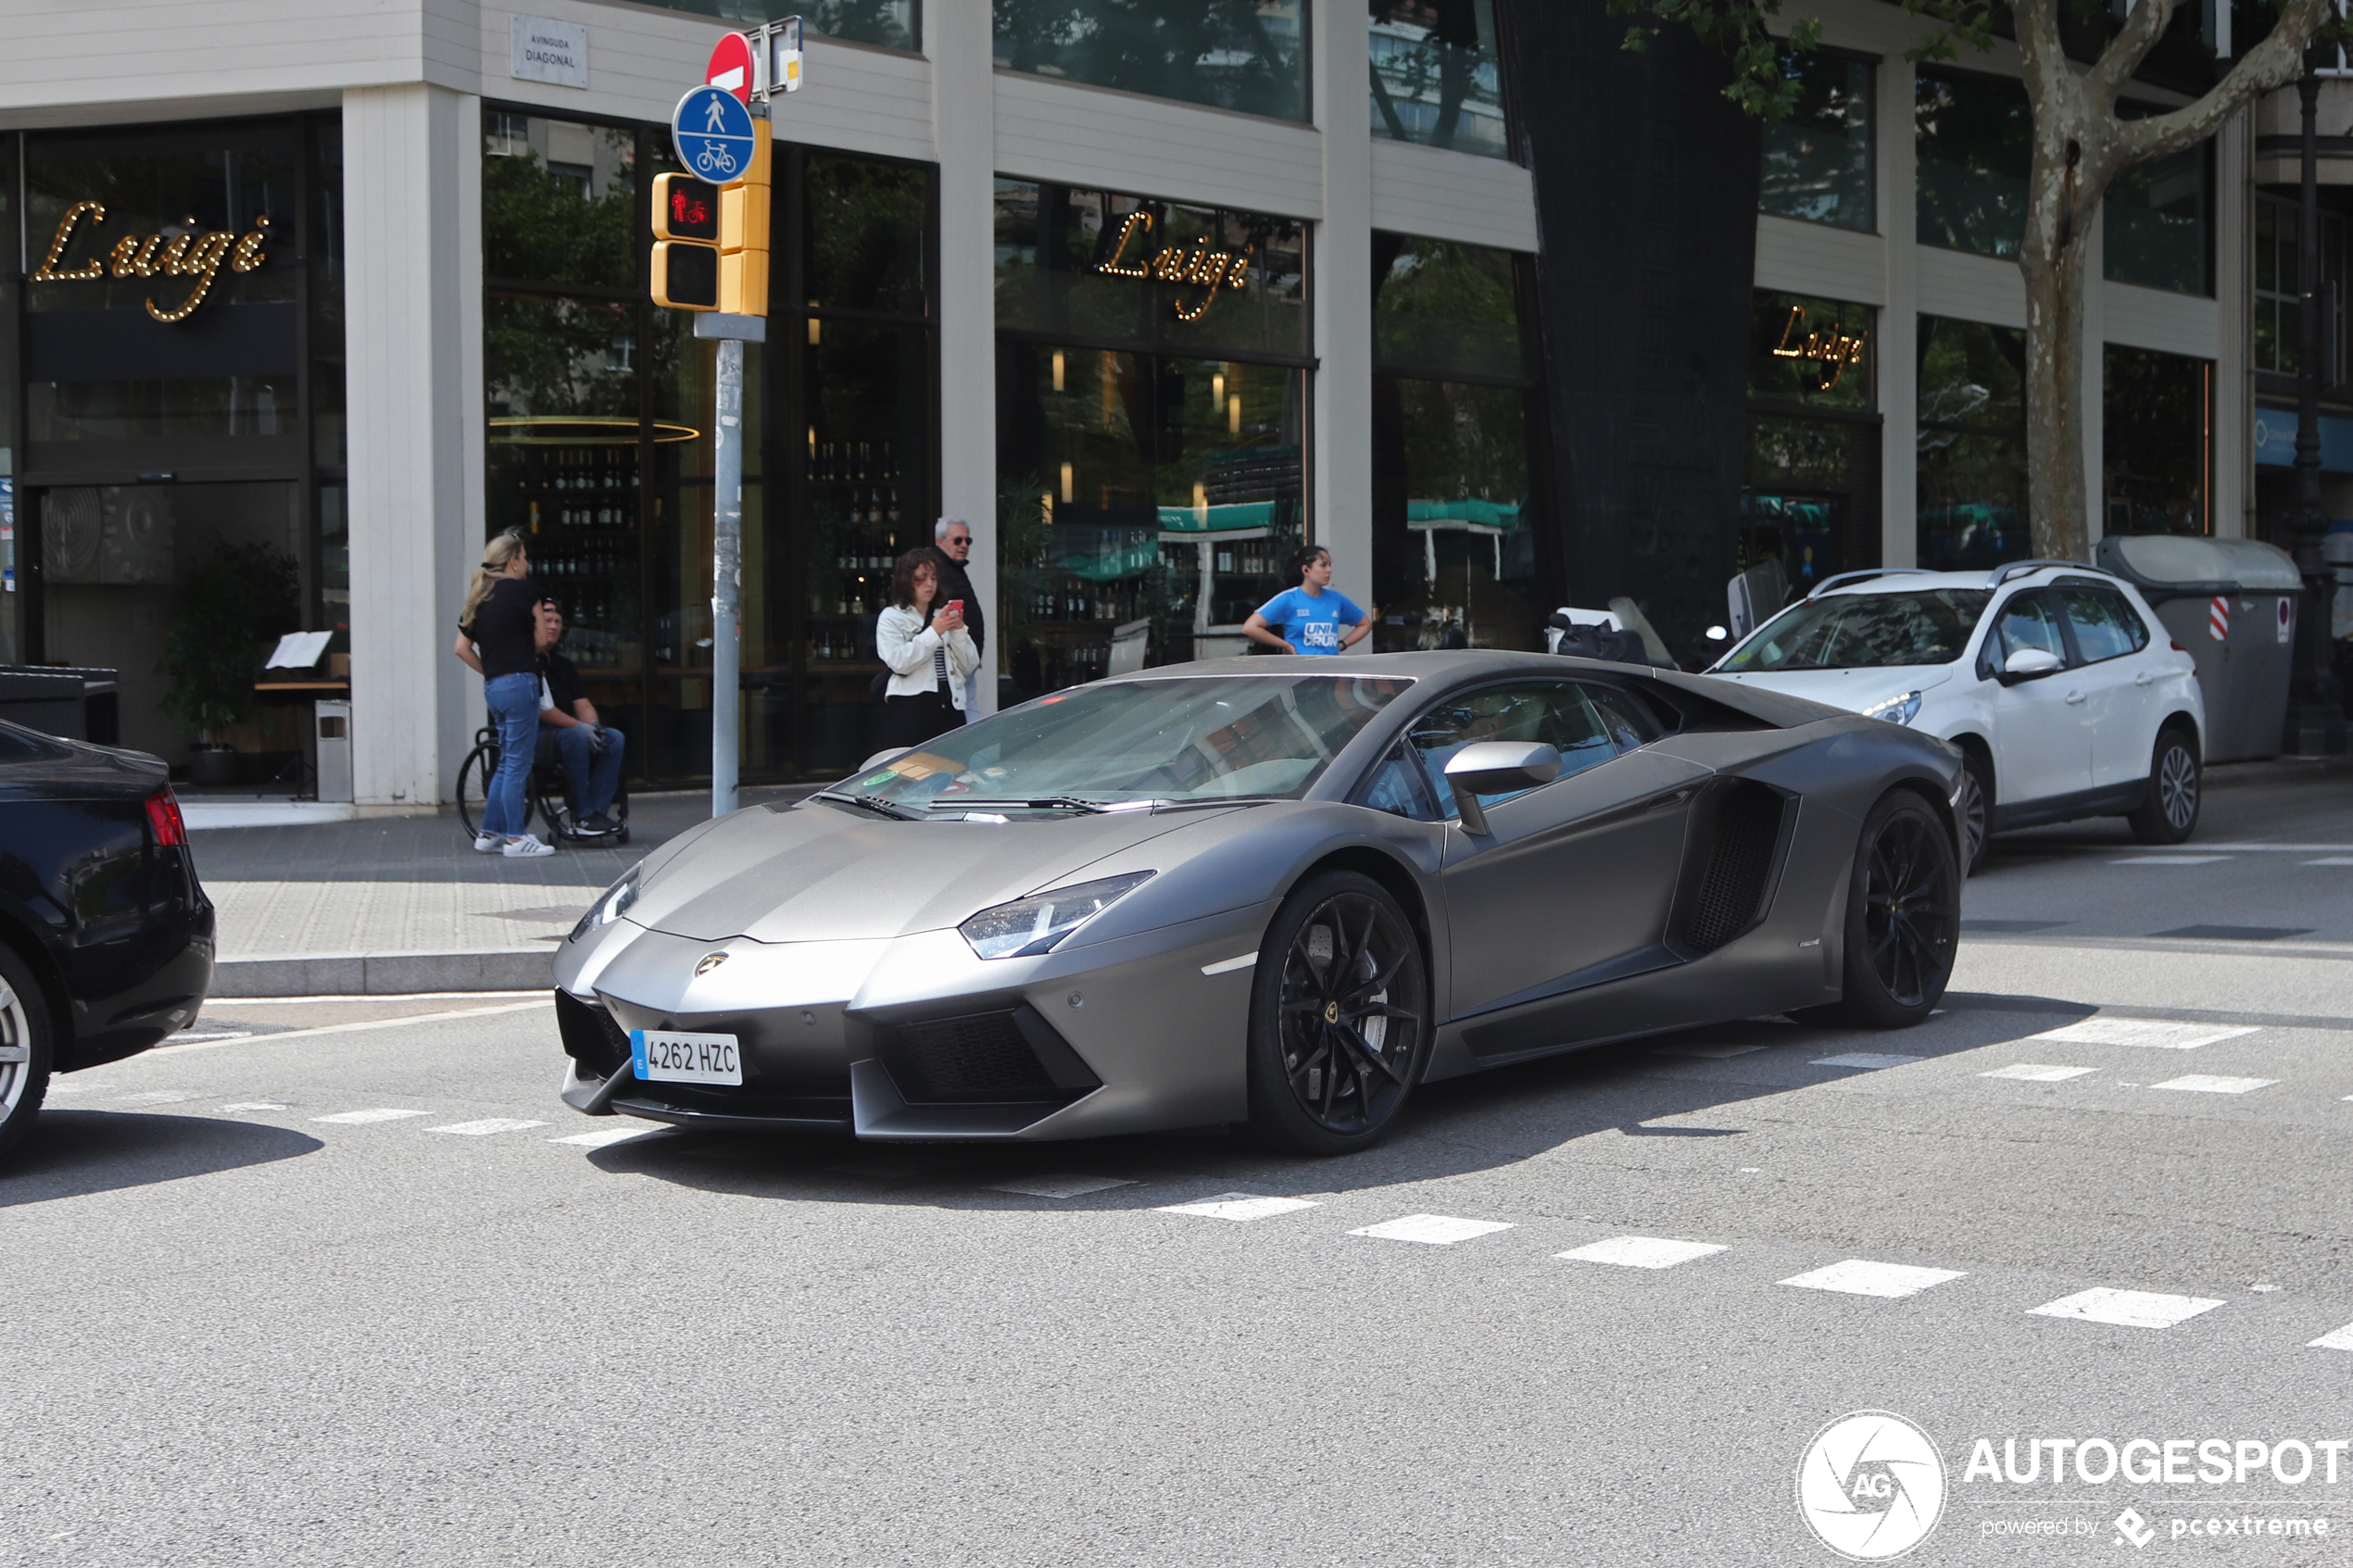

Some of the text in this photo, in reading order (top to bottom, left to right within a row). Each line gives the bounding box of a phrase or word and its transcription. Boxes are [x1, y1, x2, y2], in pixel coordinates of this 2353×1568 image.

[531, 35, 570, 49] AVINGUDA
[525, 49, 575, 69] DIAGONAL
[29, 200, 270, 322] Luigi
[1099, 211, 1253, 321] Luigi
[1772, 305, 1868, 390] Luigi
[1306, 623, 1332, 636] UNI
[636, 1059, 644, 1070] E
[649, 1041, 736, 1073] 4262 HZC
